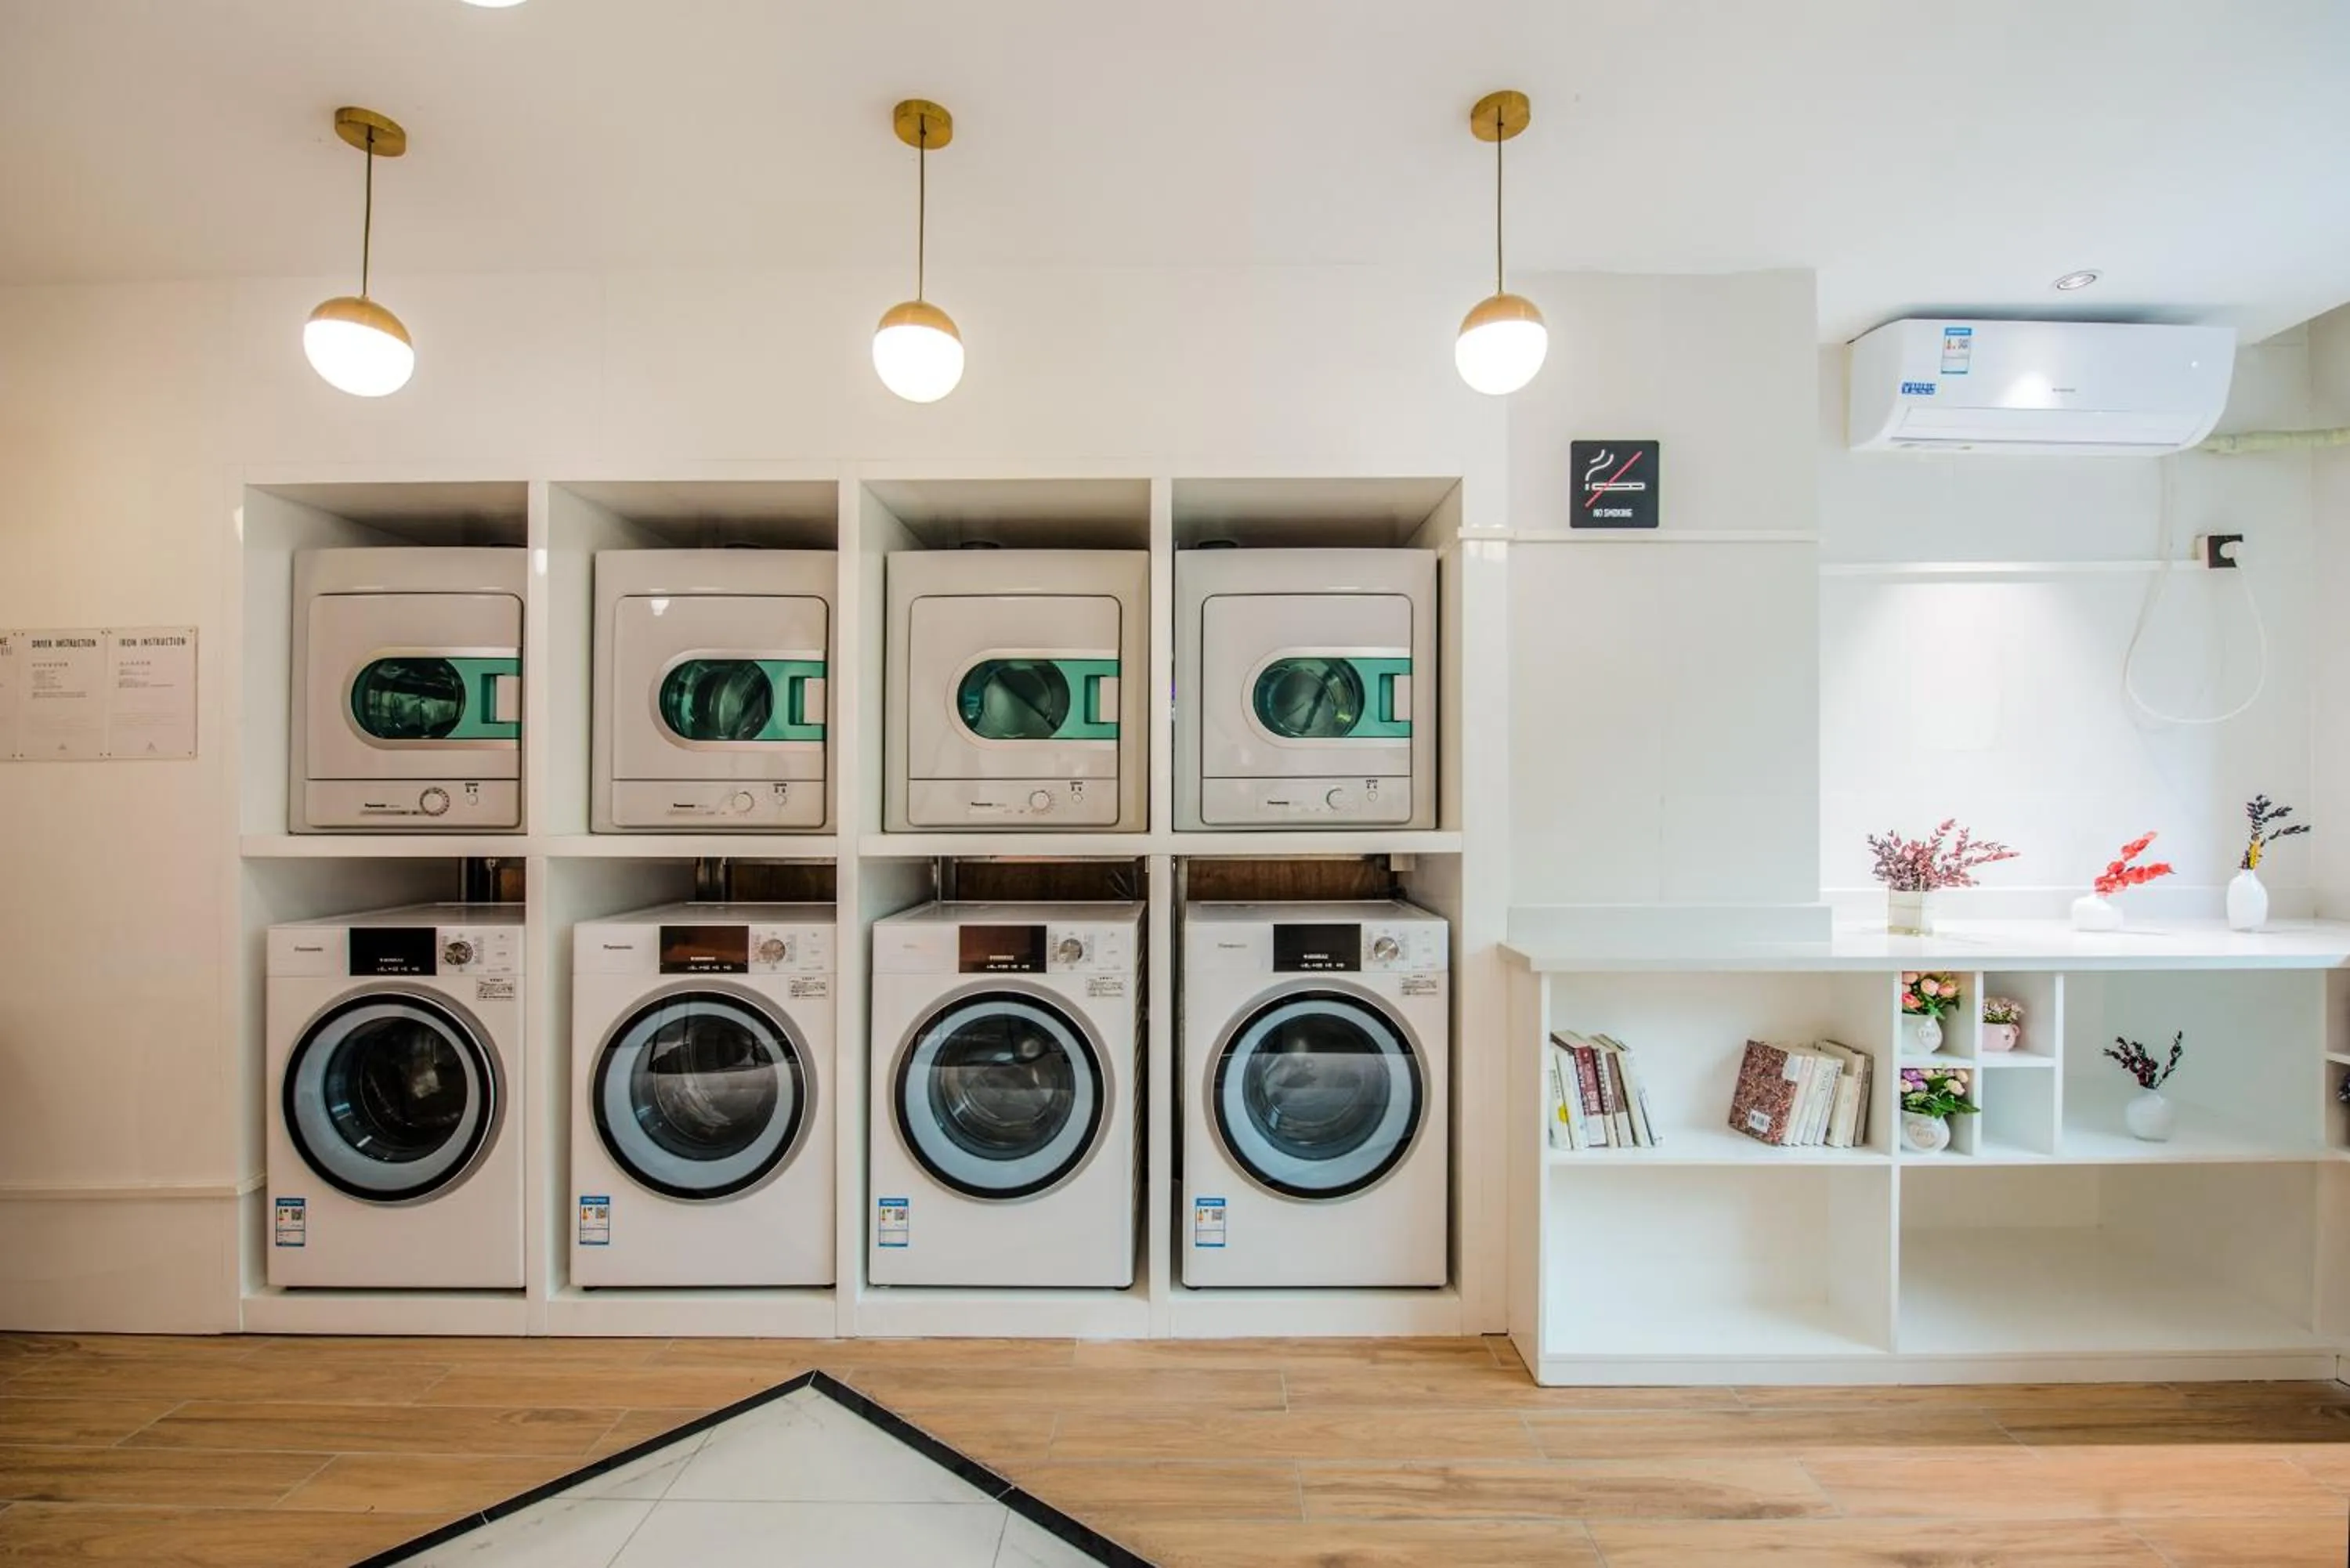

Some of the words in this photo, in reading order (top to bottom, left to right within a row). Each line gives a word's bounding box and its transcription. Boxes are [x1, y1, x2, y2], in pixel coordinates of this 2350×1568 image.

[1593, 508, 1603, 517] NO
[1603, 508, 1632, 517] SMOKING
[140, 636, 186, 646] INSTRUCTION
